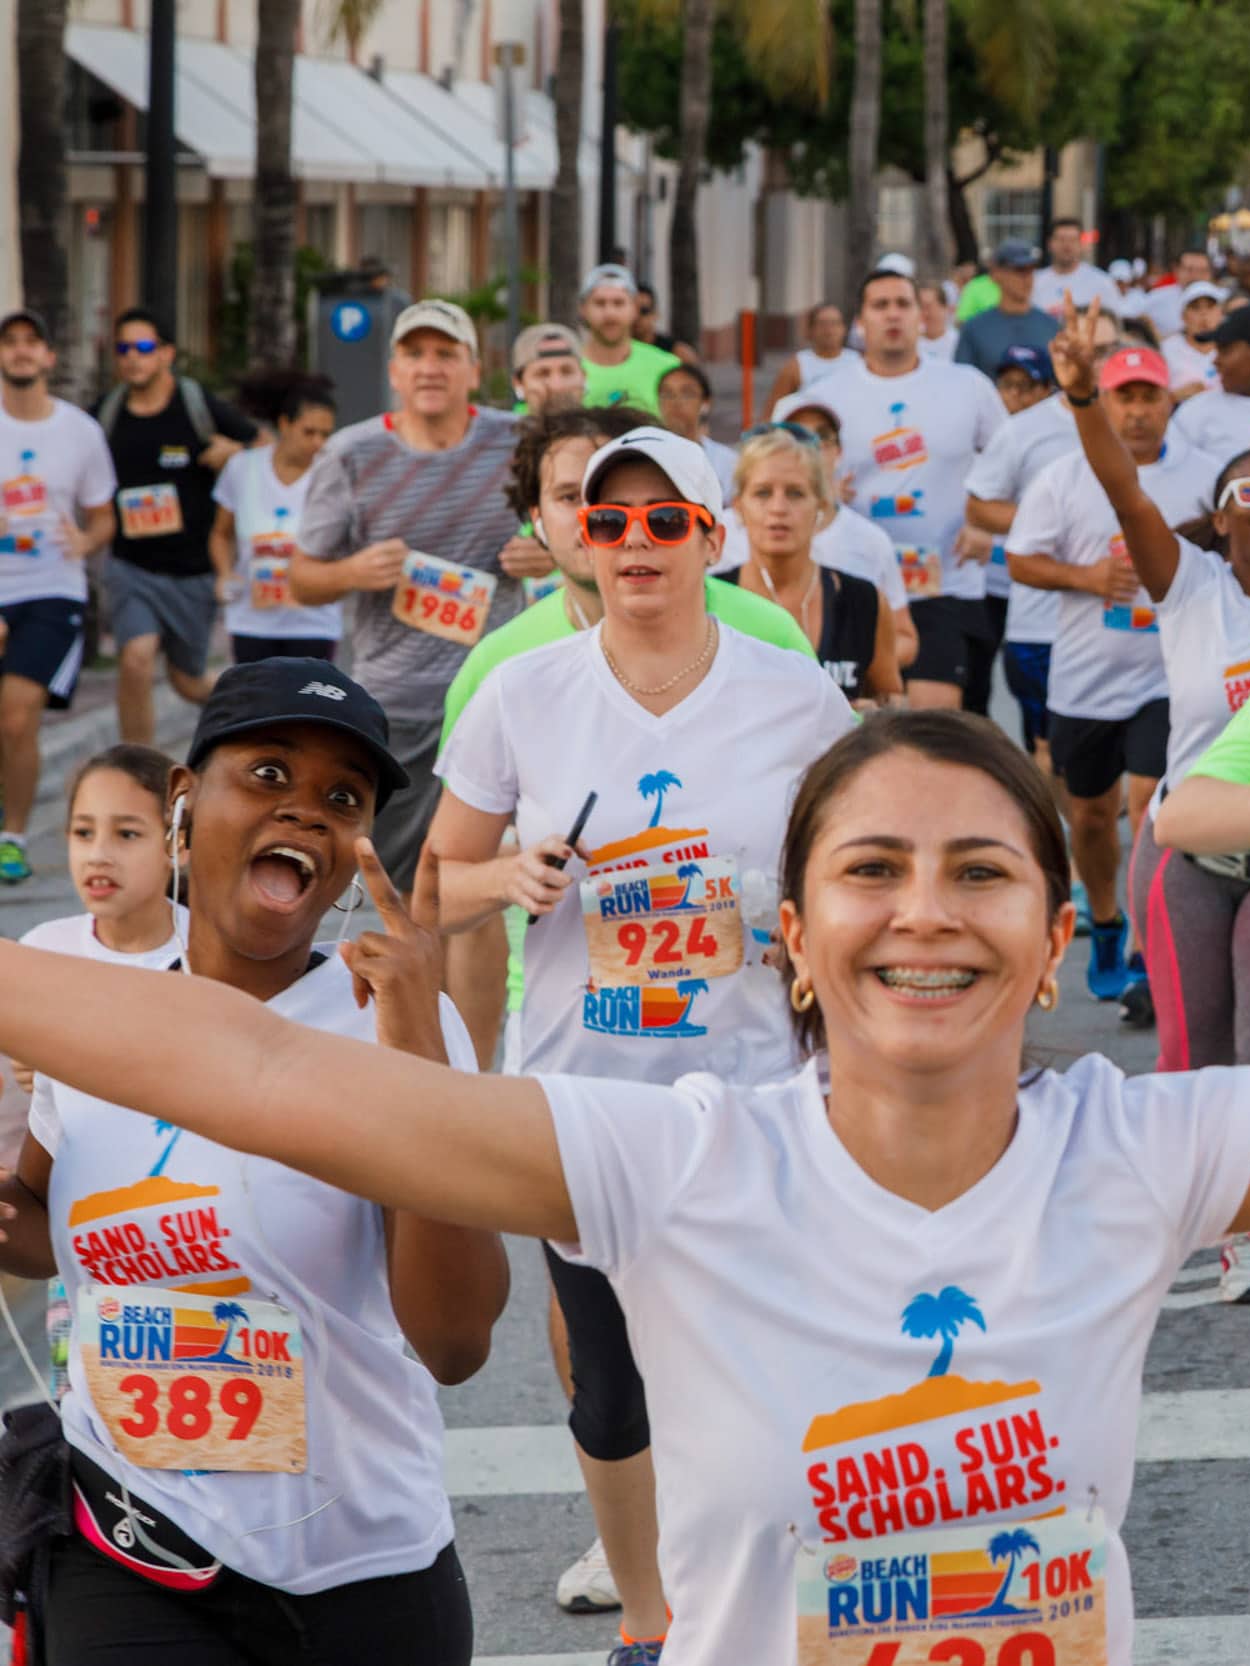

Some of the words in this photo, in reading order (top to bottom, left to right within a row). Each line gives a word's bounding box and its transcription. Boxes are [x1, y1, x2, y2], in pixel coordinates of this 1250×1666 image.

[341, 307, 363, 335] P
[404, 588, 476, 632] 1986
[600, 889, 650, 917] RUN
[614, 879, 648, 897] BEACH
[704, 876, 733, 900] 5K
[617, 917, 718, 966] 924
[647, 968, 691, 980] Wanda
[584, 993, 640, 1030] RUN
[159, 1206, 231, 1247] SUN.
[88, 1240, 240, 1287] SCHOLARS.
[100, 1323, 172, 1361] RUN
[123, 1305, 172, 1325] BEACH
[236, 1327, 292, 1362] 10K
[256, 1362, 293, 1379] 2018
[119, 1374, 264, 1441] 389
[807, 1442, 945, 1509] SAND.
[954, 1409, 1060, 1474] SUN.
[818, 1455, 1066, 1544] SCHOLARS.
[860, 1554, 927, 1581] BEACH
[1020, 1549, 1093, 1602] 10K
[828, 1577, 929, 1628] RUN
[1049, 1594, 1094, 1622] 2018
